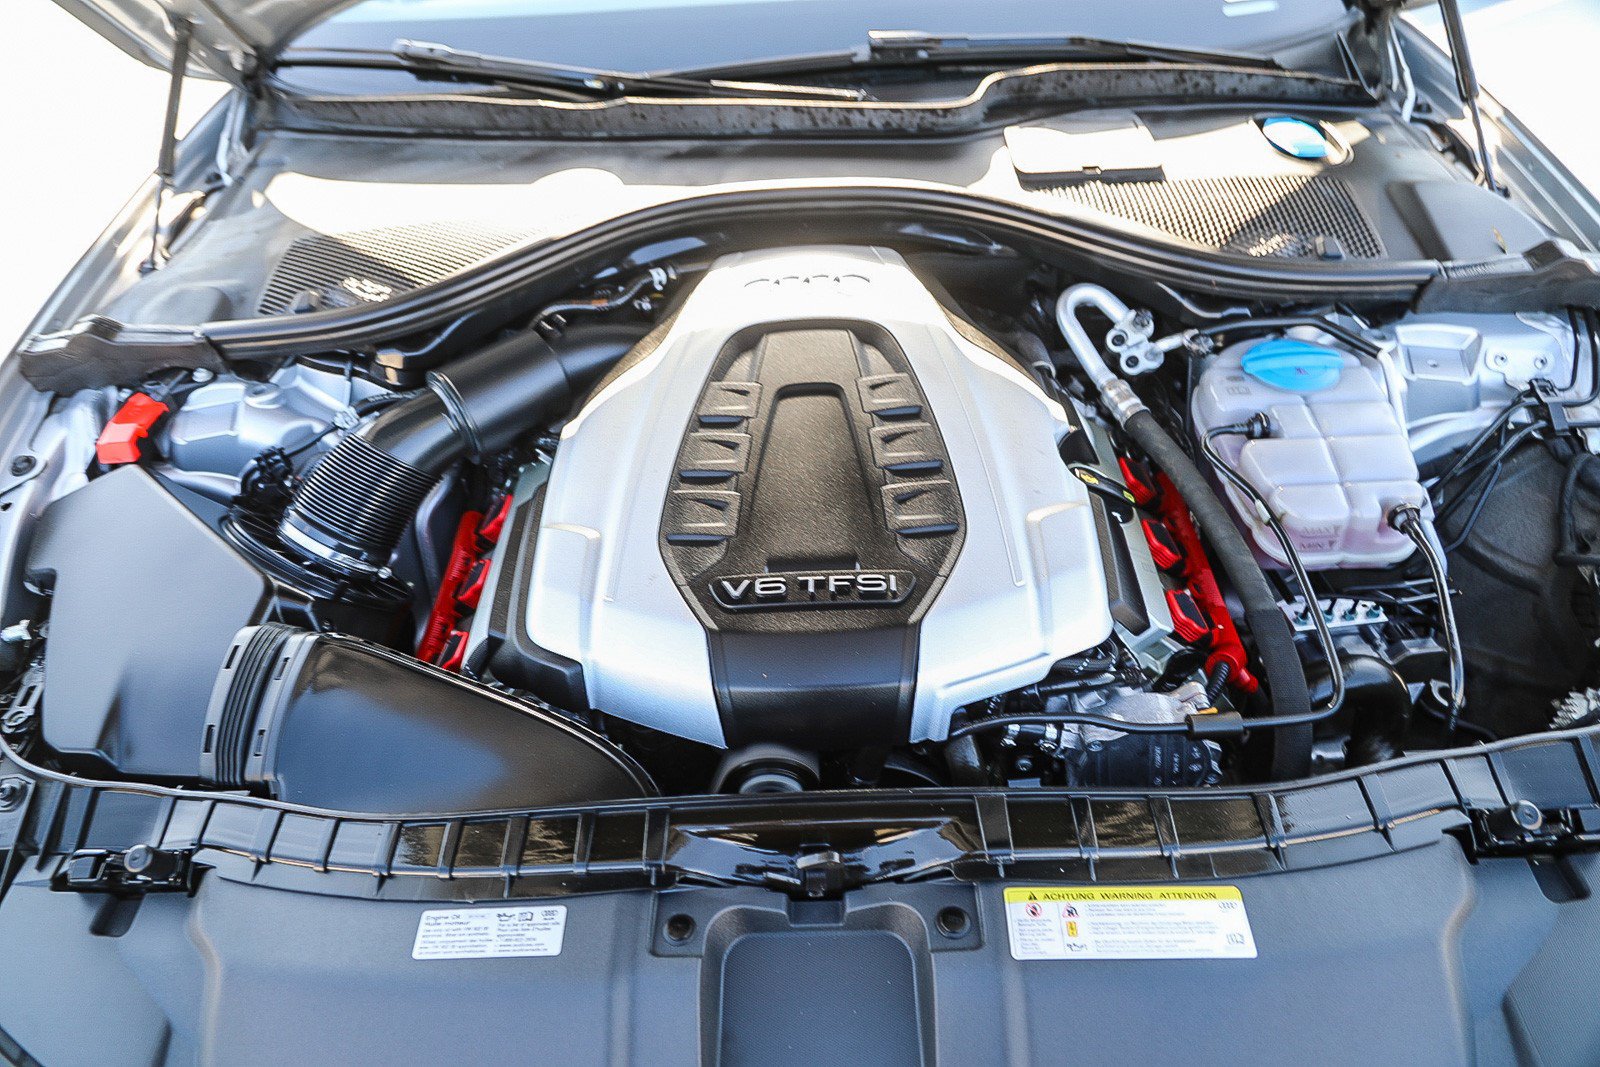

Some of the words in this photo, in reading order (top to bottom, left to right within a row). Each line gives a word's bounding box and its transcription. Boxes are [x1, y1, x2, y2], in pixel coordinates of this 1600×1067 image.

[721, 576, 787, 599] V6
[797, 574, 898, 595] TFSI
[1042, 892, 1095, 901] ACHTUNG
[1100, 891, 1153, 900] WARNING
[1159, 891, 1217, 900] ATTENTION
